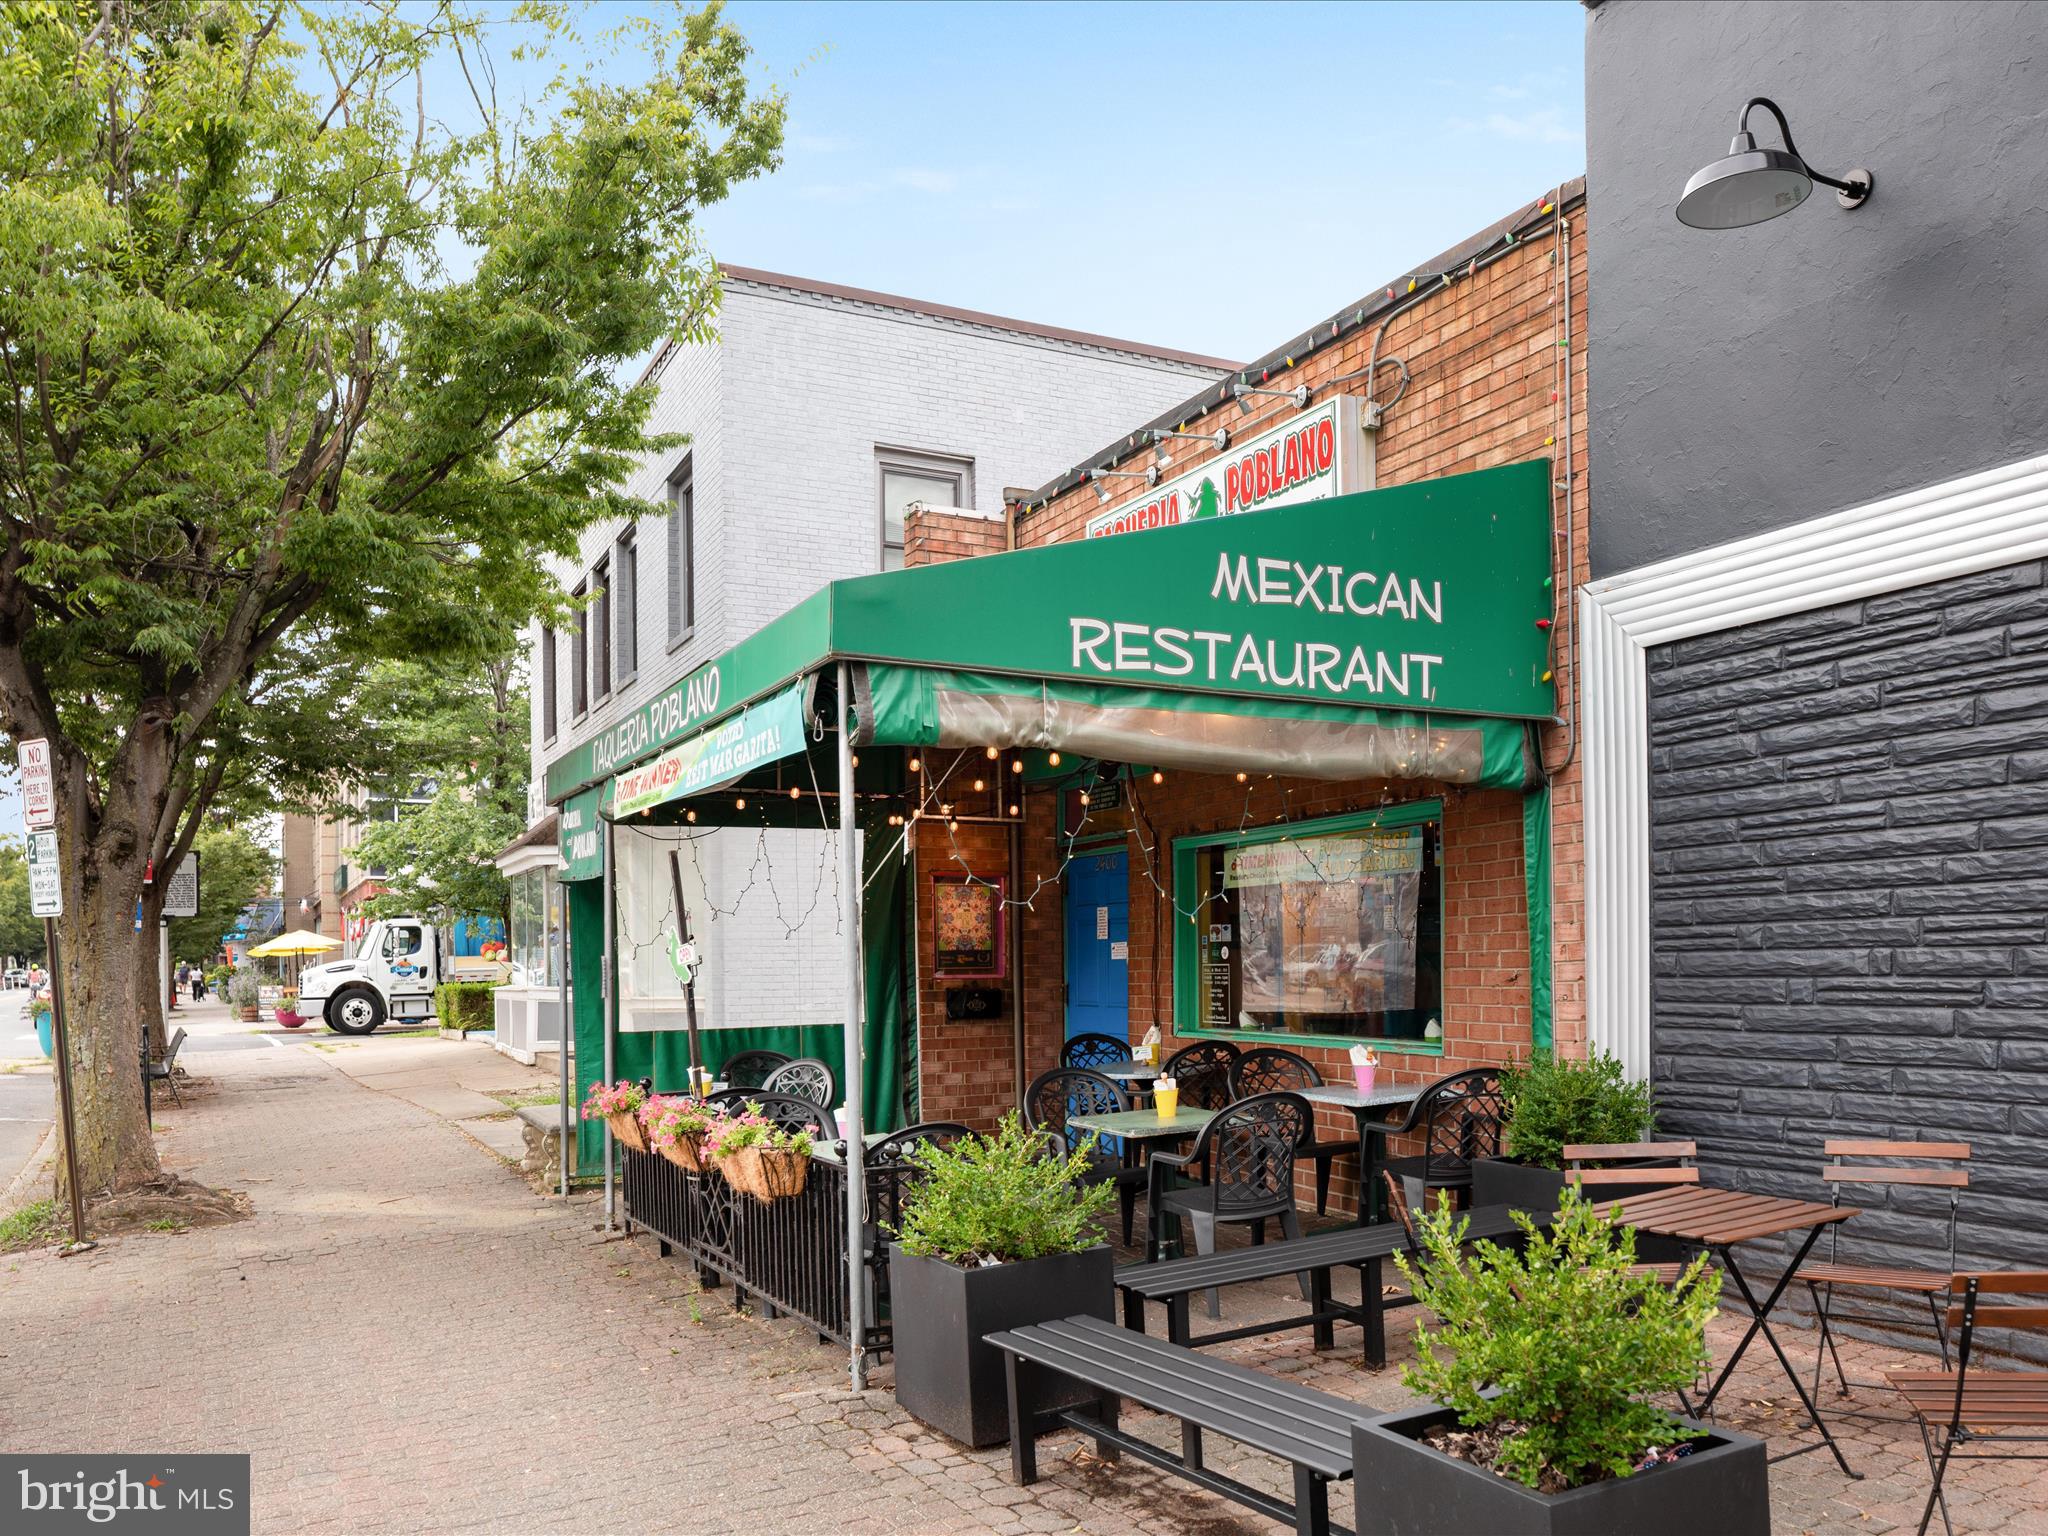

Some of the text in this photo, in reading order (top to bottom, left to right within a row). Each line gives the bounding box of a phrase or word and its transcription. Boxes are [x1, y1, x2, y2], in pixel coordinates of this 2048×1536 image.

[1225, 415, 1334, 515] POBLANO
[1210, 552, 1443, 624] MEXICAN
[1069, 617, 1443, 699] RESTAURANT
[650, 666, 720, 742] POBLANO
[28, 747, 41, 764] NO
[709, 724, 781, 778] MARGARITA!
[23, 764, 48, 779] PARKING
[25, 782, 49, 796] HERE TO
[28, 795, 48, 807] CORNER
[28, 839, 36, 859] 2
[37, 849, 57, 859] PARKING
